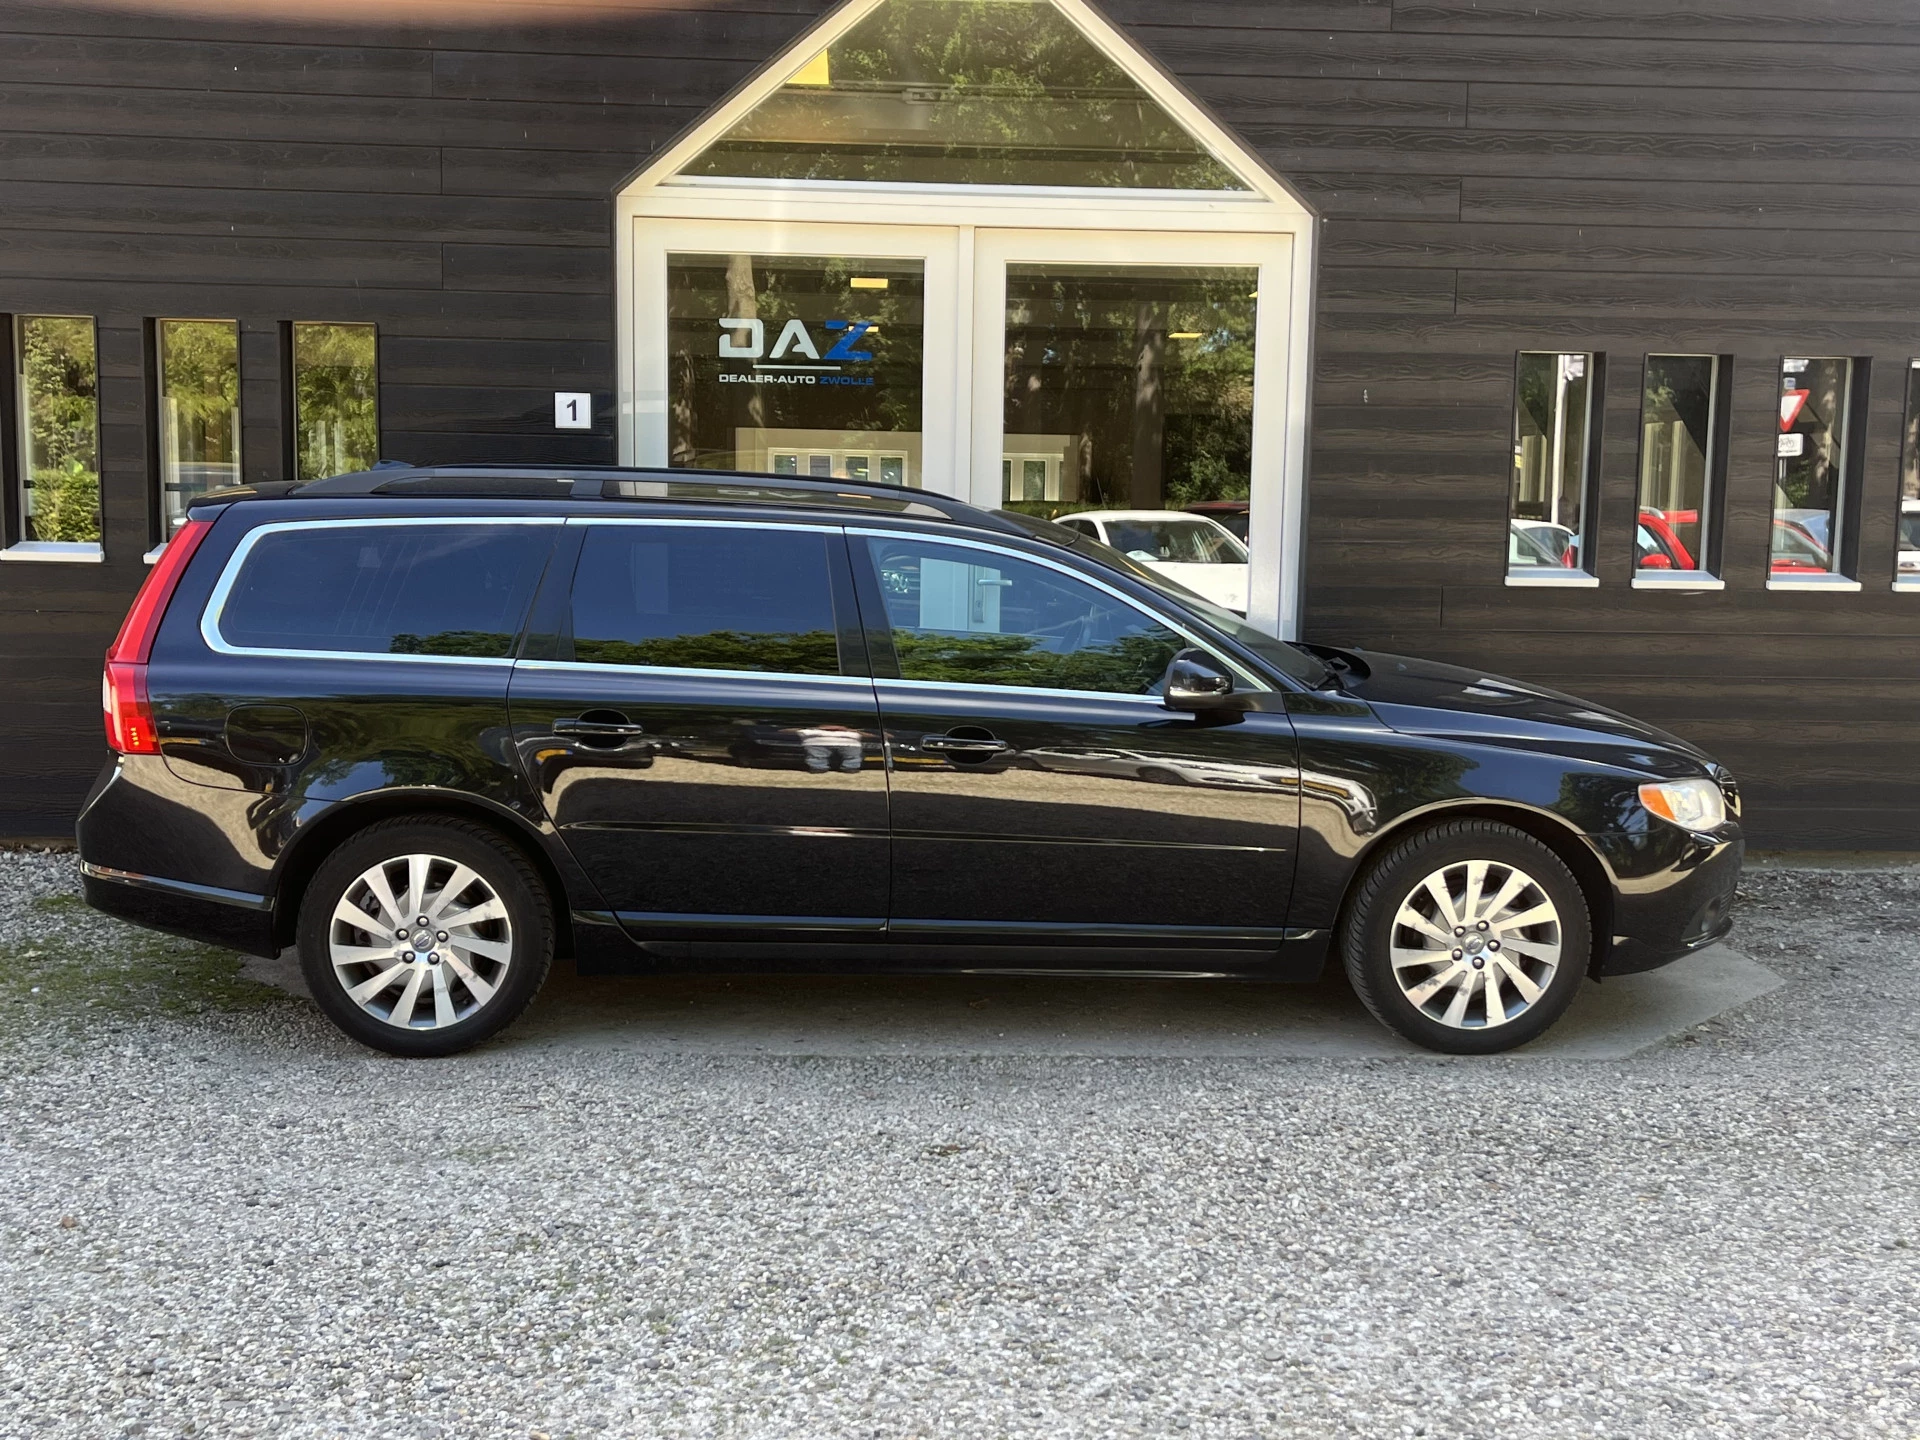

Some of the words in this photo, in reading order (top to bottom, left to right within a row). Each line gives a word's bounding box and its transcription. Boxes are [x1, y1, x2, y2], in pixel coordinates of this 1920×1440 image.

[718, 317, 873, 360] DAZ
[718, 374, 816, 384] DEALER-AUTO
[819, 376, 874, 386] ZWOLLE
[566, 399, 577, 421] 1
